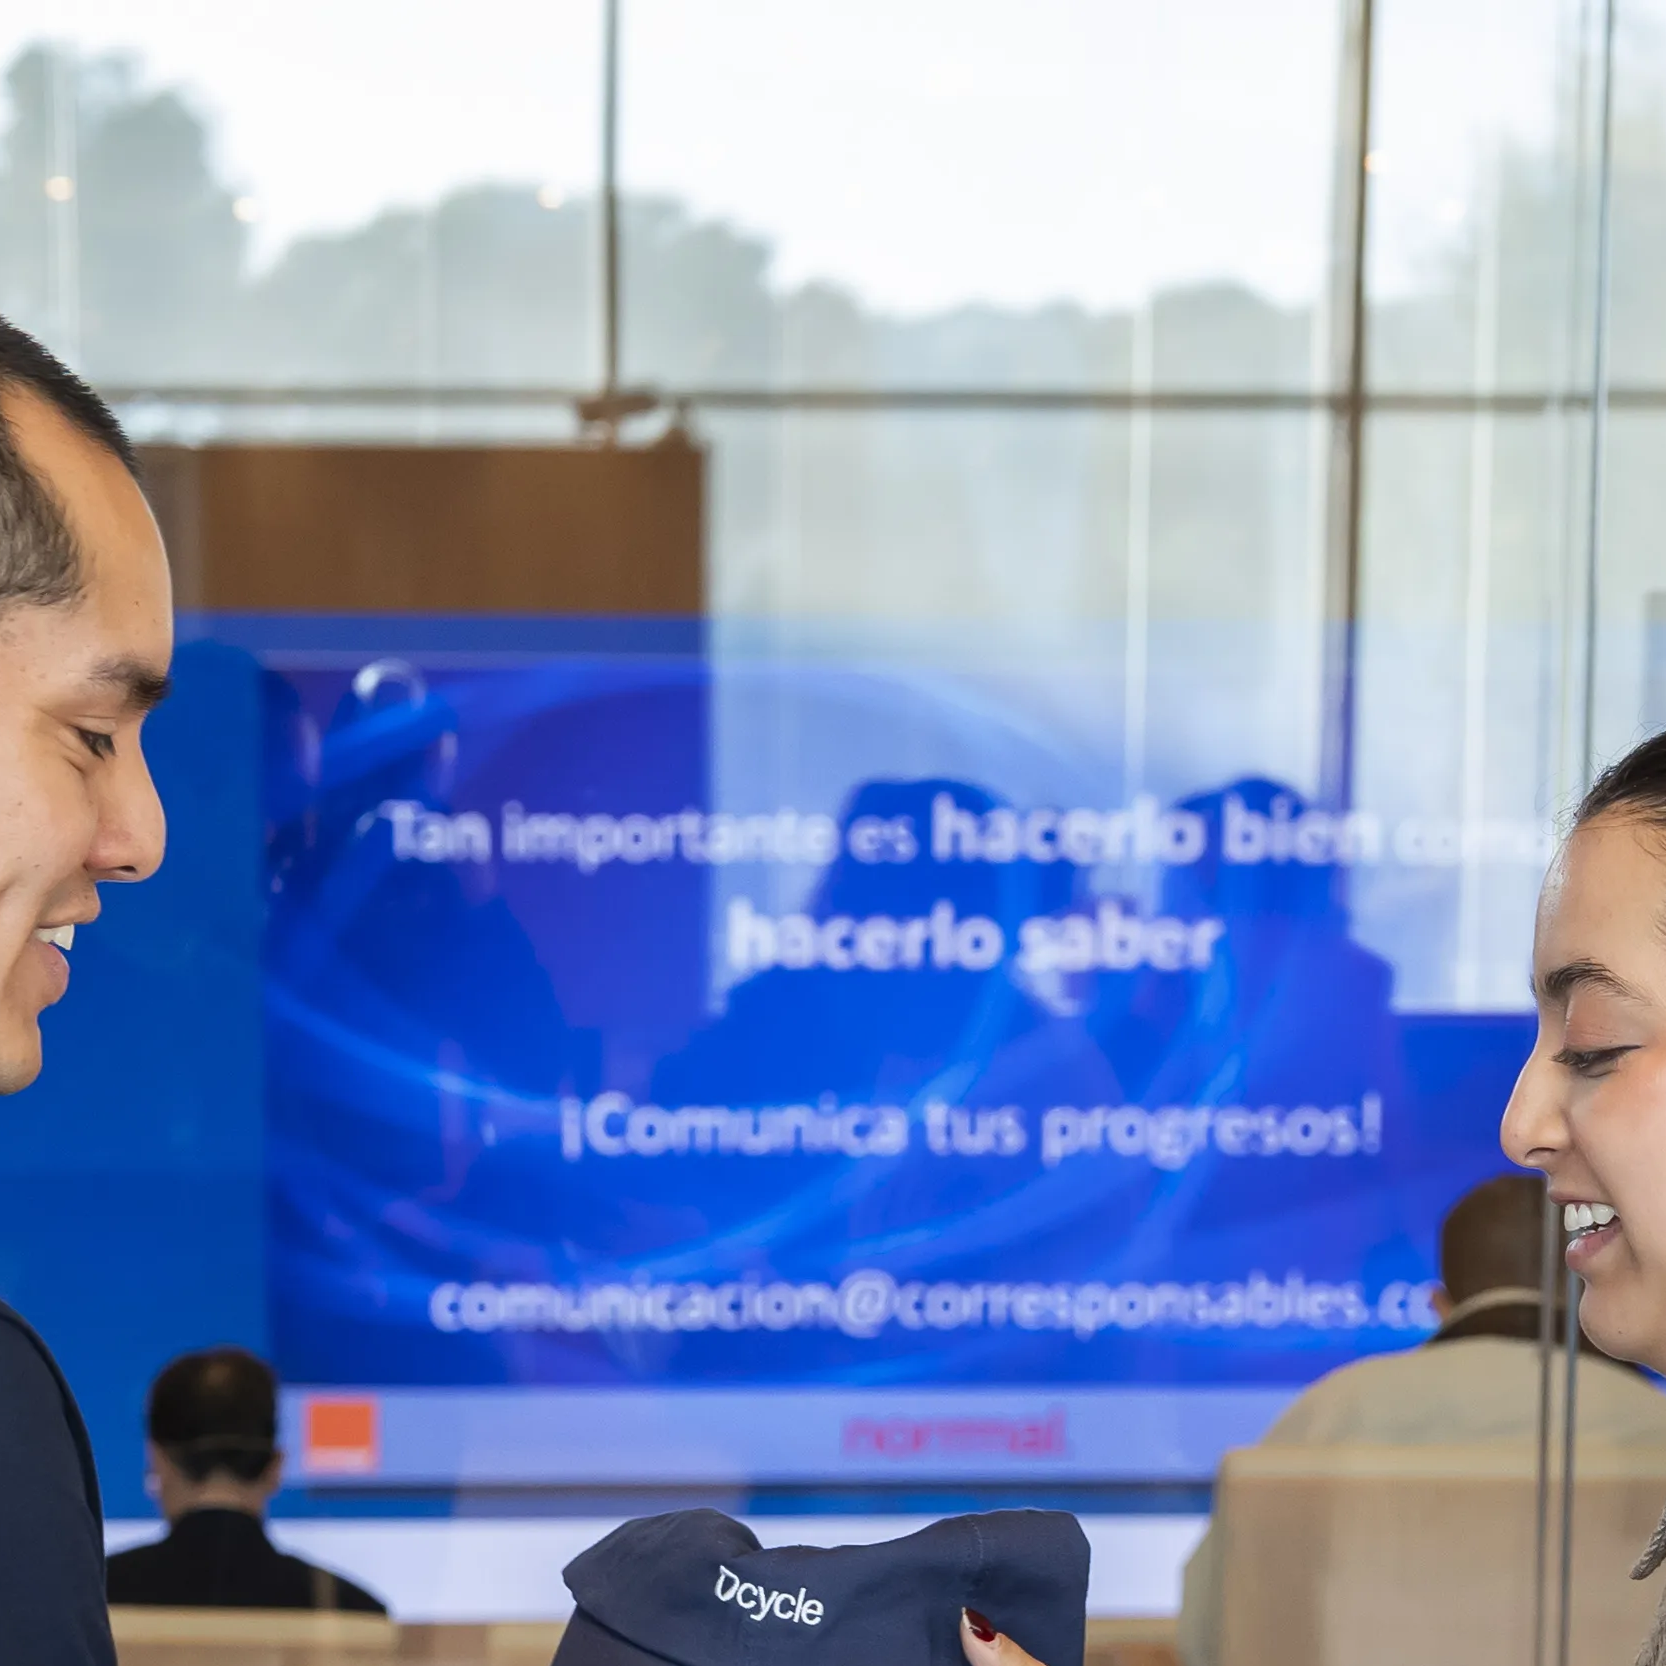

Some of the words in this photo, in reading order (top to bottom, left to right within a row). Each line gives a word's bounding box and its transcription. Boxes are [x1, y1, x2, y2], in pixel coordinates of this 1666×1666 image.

[501, 800, 835, 872] importante
[933, 793, 1205, 866] hacerlo
[1221, 793, 1380, 866] bien
[726, 897, 1004, 971] hacerlo
[1019, 898, 1225, 973] saber
[925, 1097, 1026, 1157] tus
[1042, 1091, 1382, 1171] progresos!
[714, 1564, 824, 1626] Dcycle
